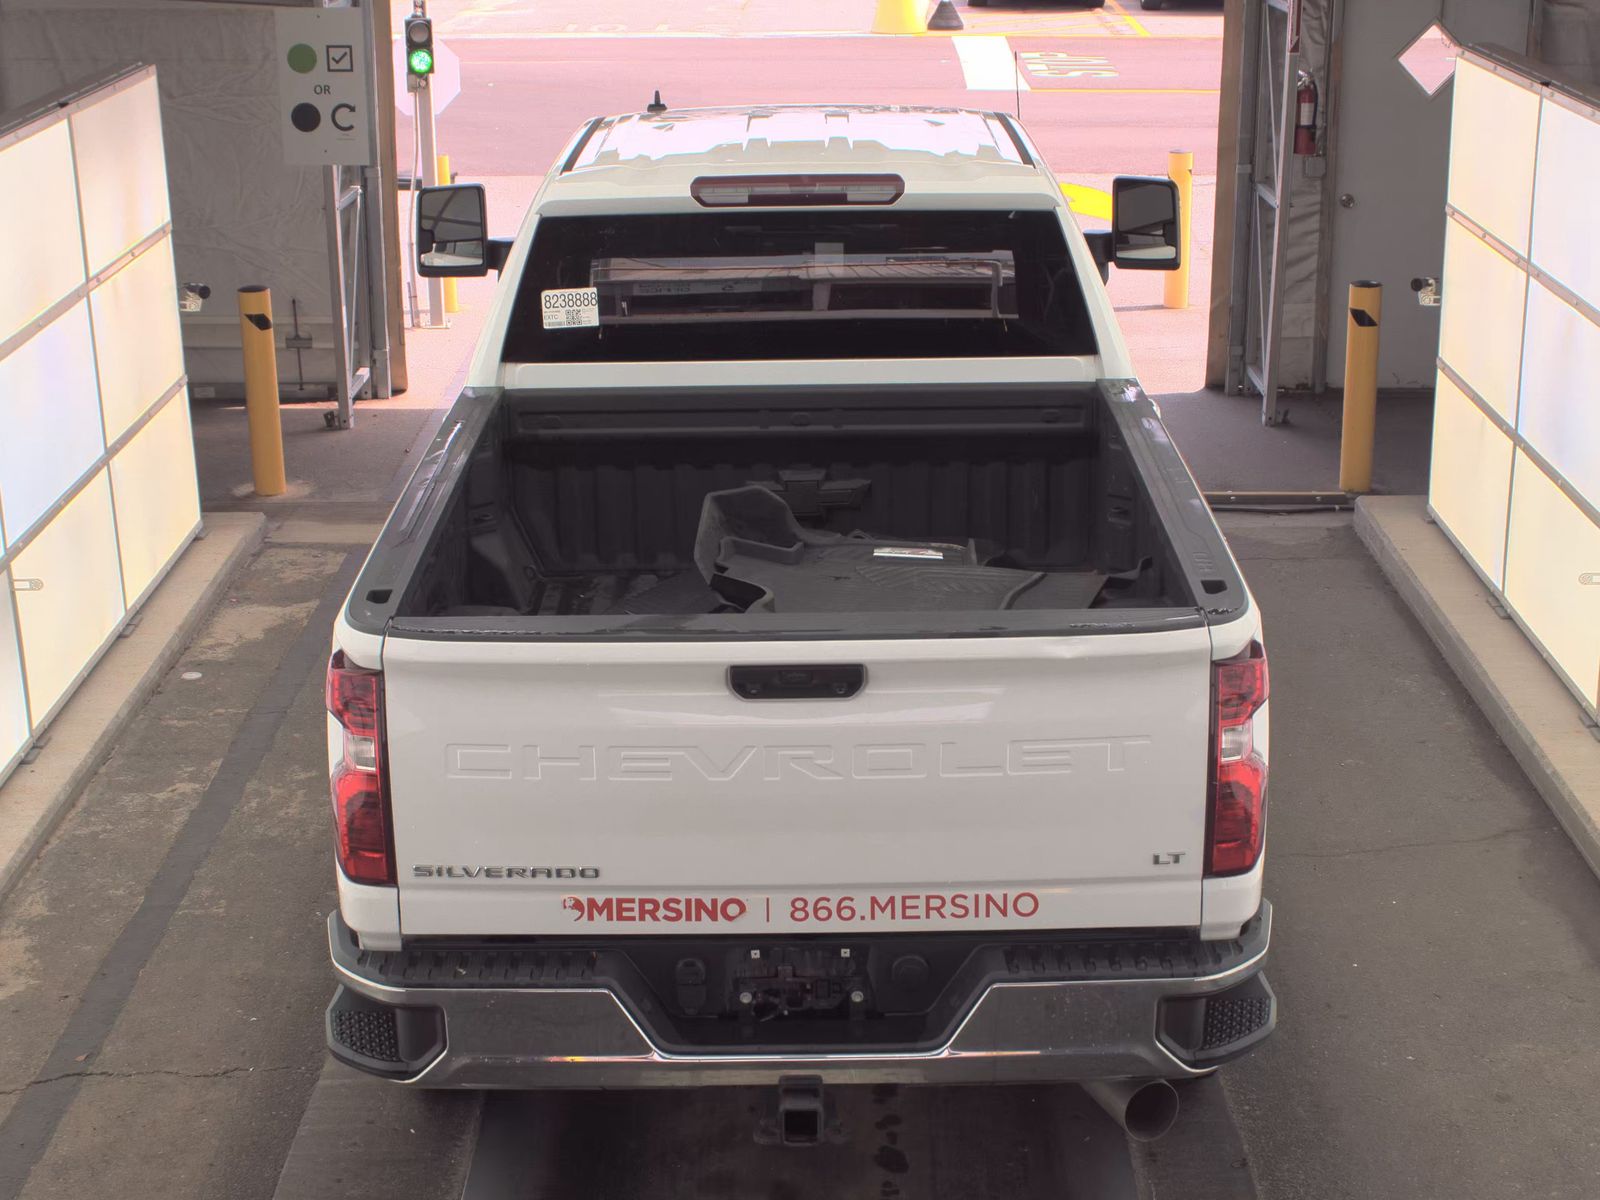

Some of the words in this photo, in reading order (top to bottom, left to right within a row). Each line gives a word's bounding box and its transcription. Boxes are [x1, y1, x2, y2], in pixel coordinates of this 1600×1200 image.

[313, 85, 331, 95] OR
[544, 292, 598, 309] 8238888
[446, 735, 1152, 781] CHEVROLET
[1152, 852, 1187, 866] LT
[412, 864, 601, 880] SILVERADO
[586, 897, 748, 923] MERSINO
[789, 892, 1041, 923] 866.MERSINO
